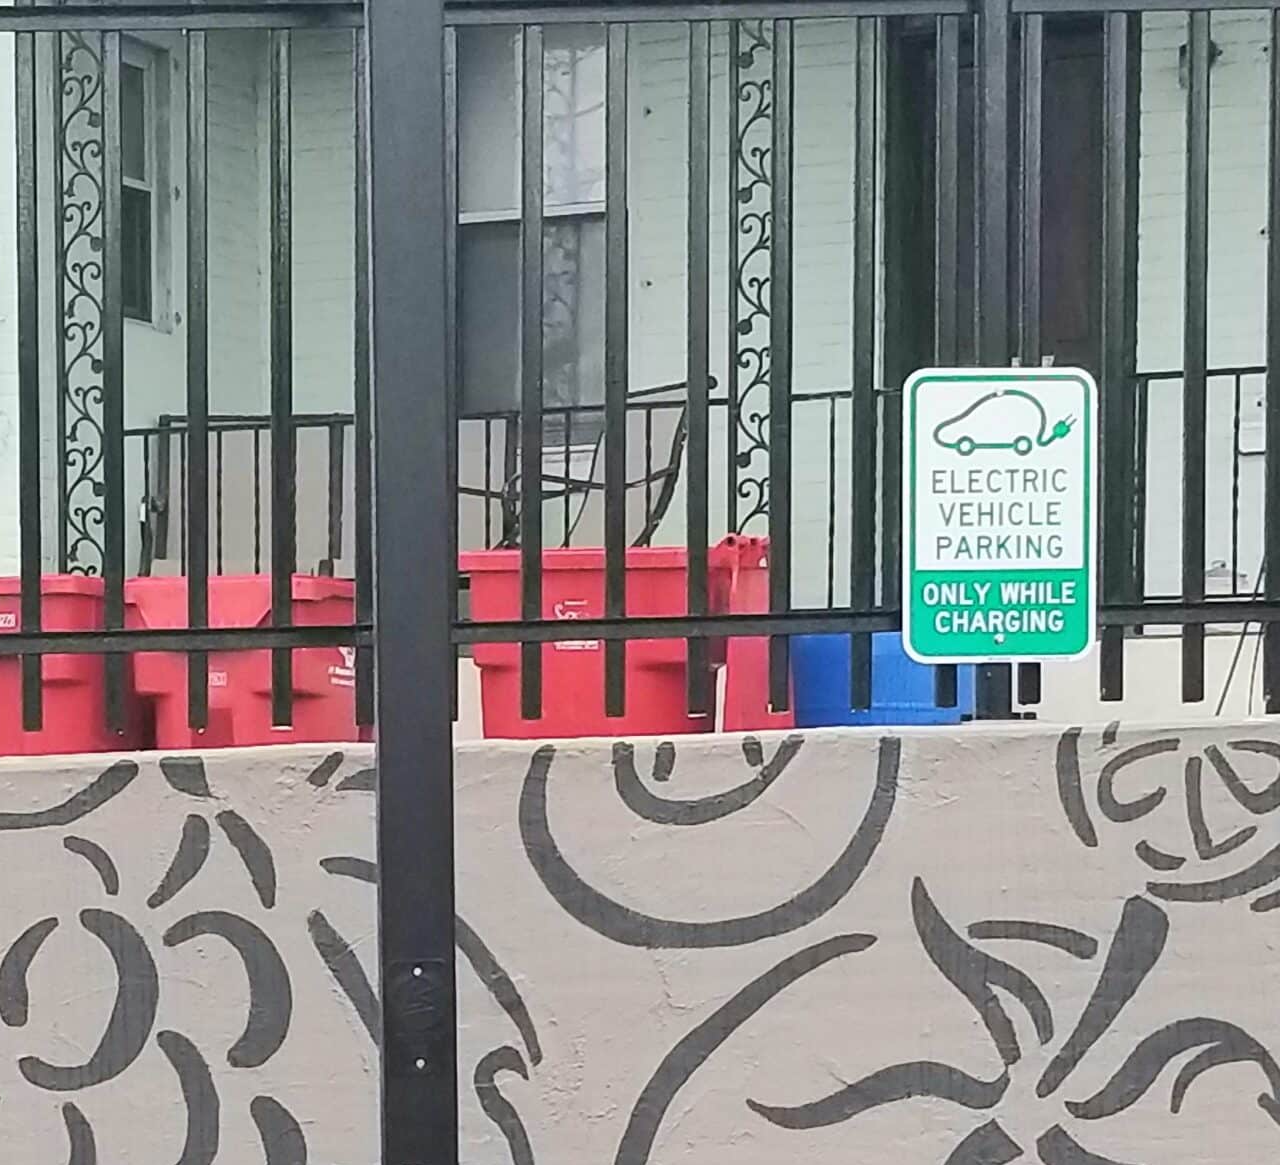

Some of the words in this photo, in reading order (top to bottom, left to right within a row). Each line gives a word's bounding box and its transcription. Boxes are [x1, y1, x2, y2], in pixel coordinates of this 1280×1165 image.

[931, 468, 1068, 494] ELECTRIC
[938, 501, 1062, 527] VEHICLE
[935, 534, 1064, 560] PARKING
[922, 582, 992, 606] ONLY
[1000, 581, 1076, 605] WHILE
[934, 609, 1065, 633] CHARGING
